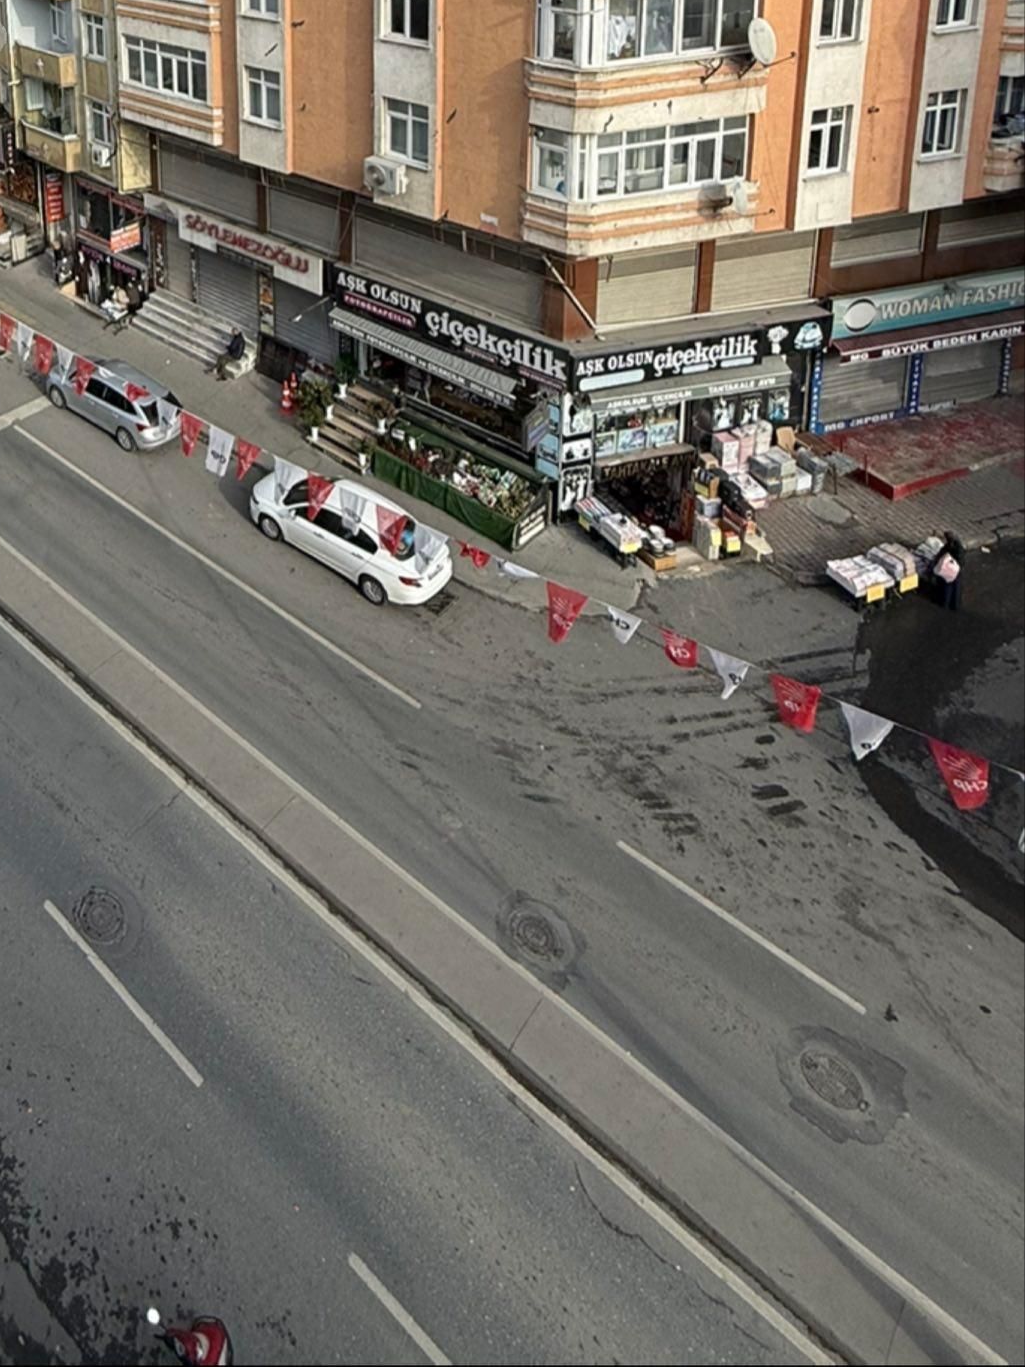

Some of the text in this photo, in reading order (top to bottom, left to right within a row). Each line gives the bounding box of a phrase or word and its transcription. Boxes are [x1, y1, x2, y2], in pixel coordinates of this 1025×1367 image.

[184, 213, 309, 274] SÖYLEMEZOĞLU
[337, 271, 422, 314] AŞK OLSUN
[880, 292, 955, 320] WOMAN
[882, 342, 929, 358] BÜYÜK
[933, 333, 977, 349] BEDEN
[576, 350, 654, 376] AŞK OLSUN
